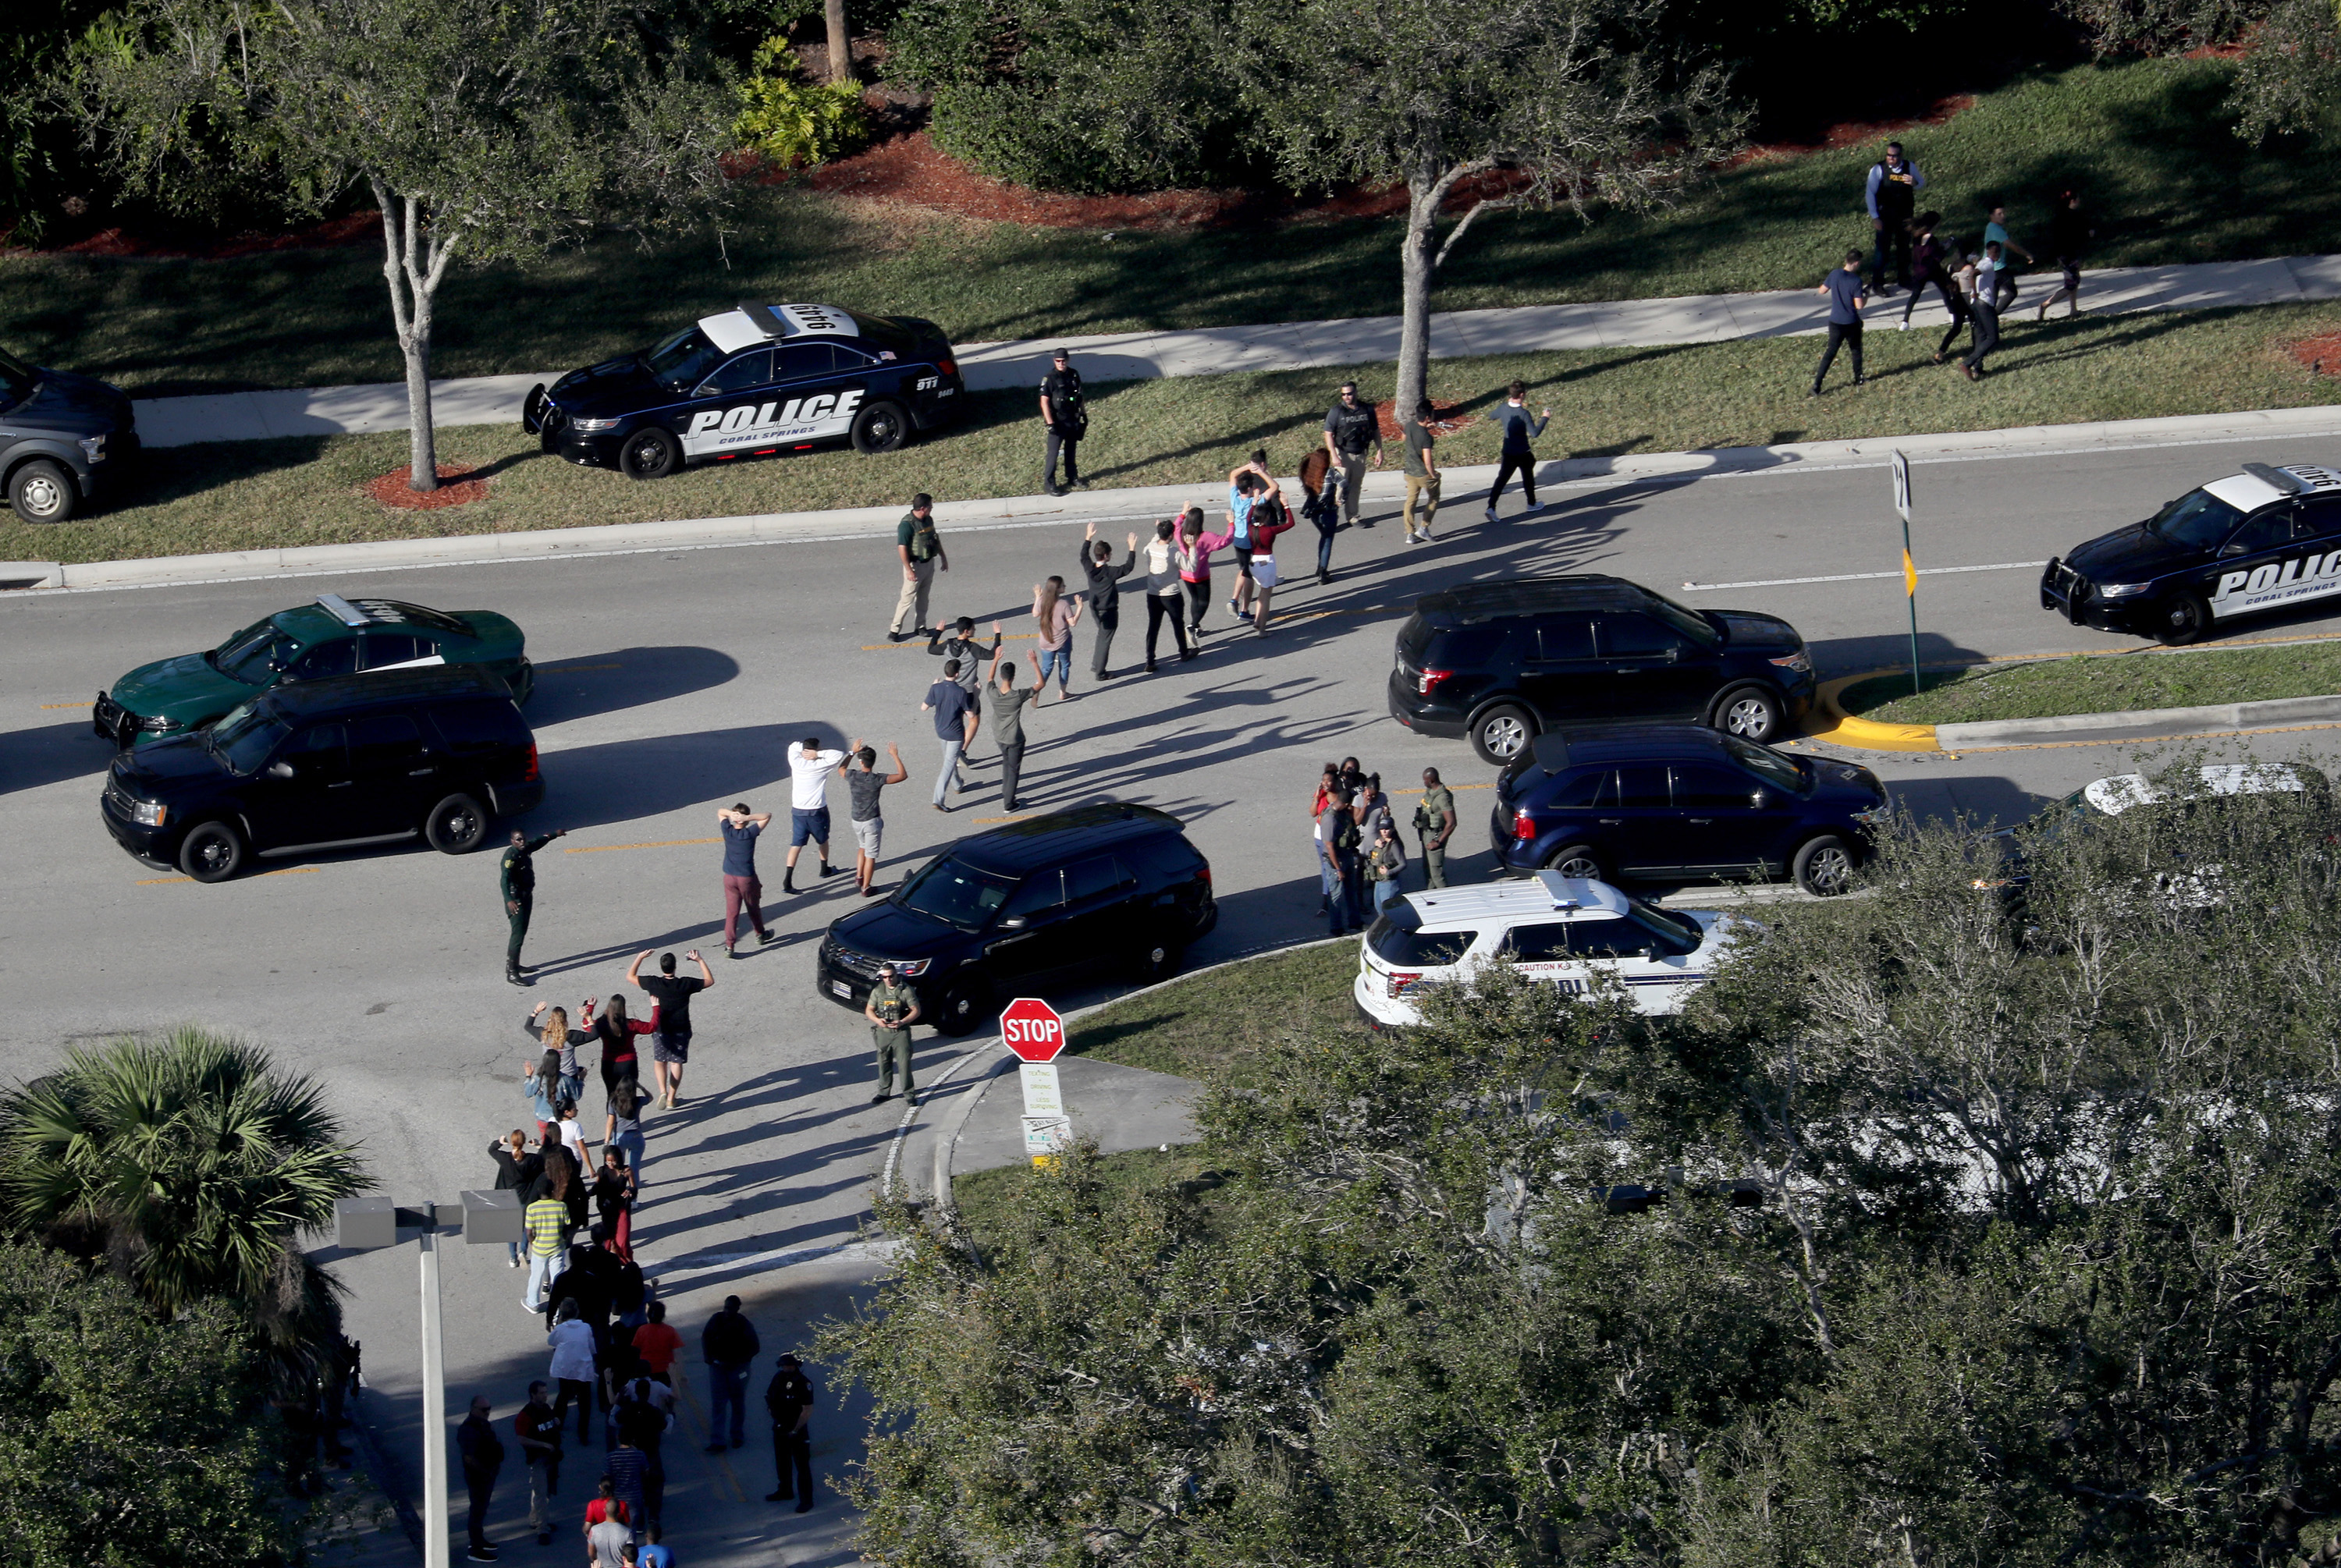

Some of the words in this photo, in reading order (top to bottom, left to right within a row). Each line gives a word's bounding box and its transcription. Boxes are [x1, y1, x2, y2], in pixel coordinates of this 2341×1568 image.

[790, 305, 836, 329] 9449
[916, 379, 938, 391] 911
[684, 389, 865, 440] POLICE
[1345, 413, 1369, 423] POLICE
[719, 434, 758, 445] CORAL
[762, 426, 816, 438] SPRINGS
[2286, 466, 2340, 486] 9400
[2245, 593, 2282, 605] CORAL
[2286, 581, 2337, 598] SPRINGS
[1519, 963, 1555, 972] CAUTION
[1007, 1019, 1059, 1042] STOP
